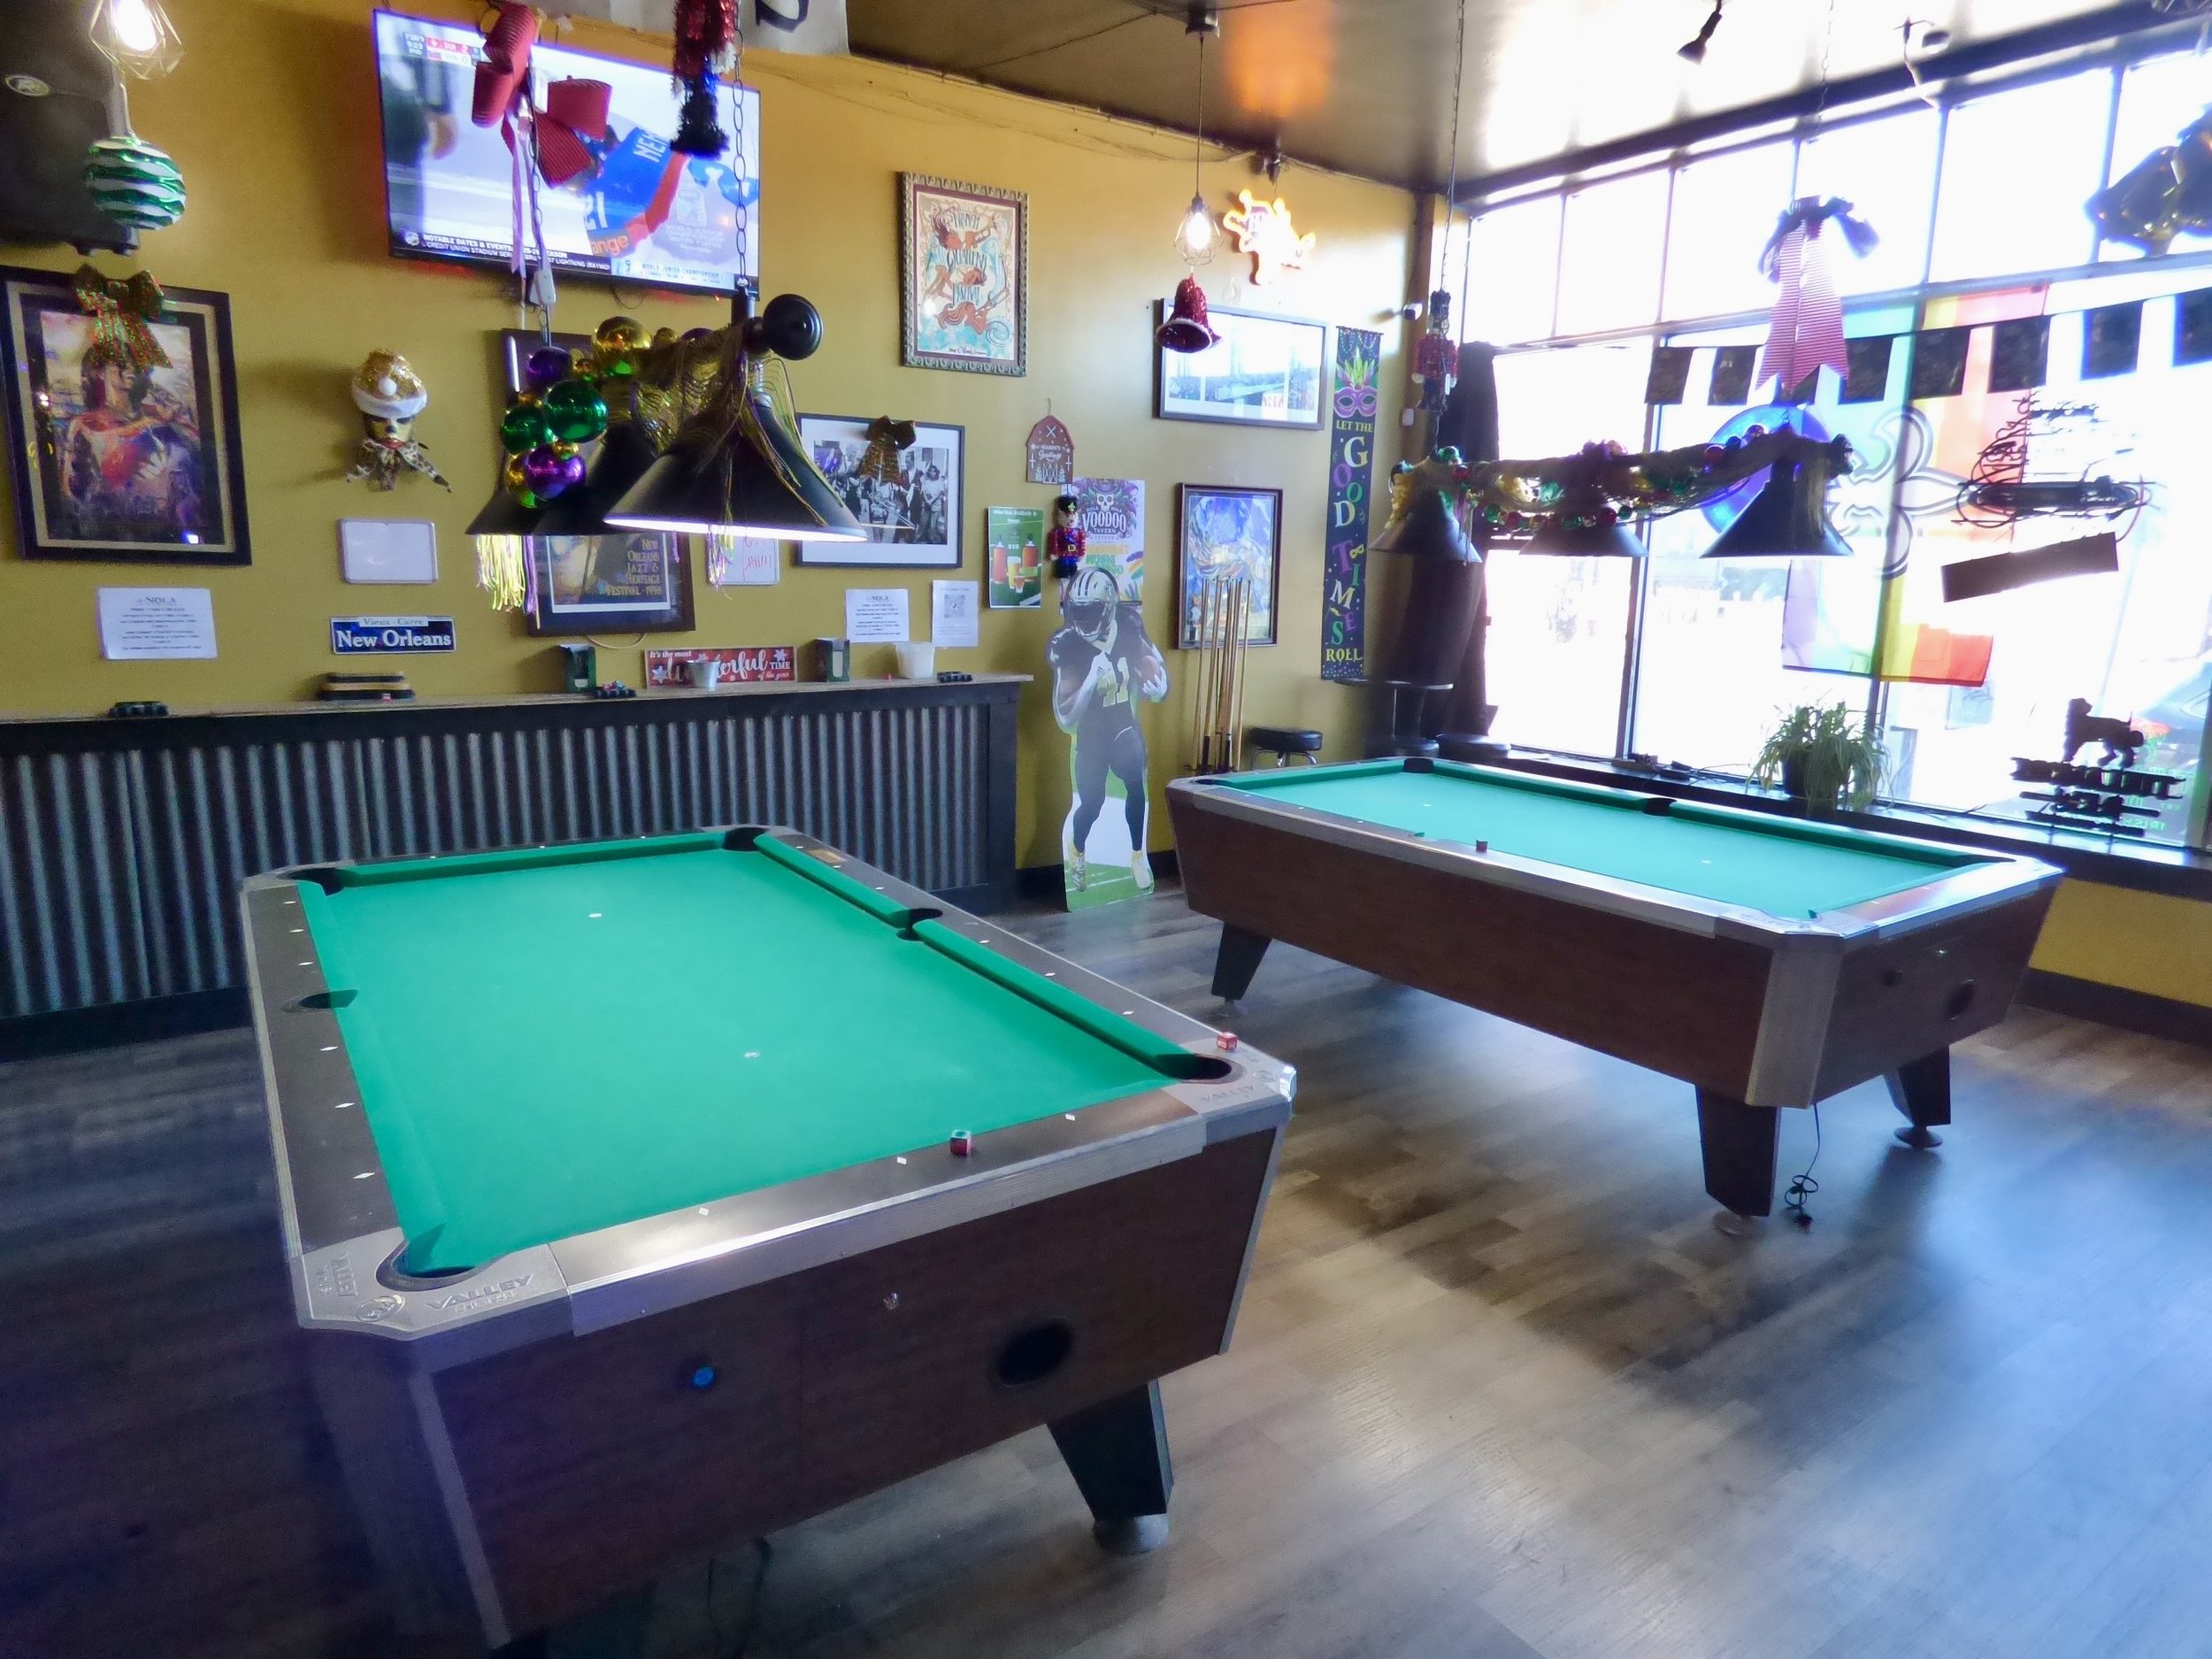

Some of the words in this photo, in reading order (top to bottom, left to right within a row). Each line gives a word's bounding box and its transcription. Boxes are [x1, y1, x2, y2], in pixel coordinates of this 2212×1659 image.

[1336, 419, 1351, 431] LET
[1353, 421, 1373, 433] THE
[1082, 511, 1127, 533] VOODOO
[335, 630, 378, 648] New
[381, 629, 452, 648] Orleans
[1325, 648, 1363, 662] ROLL
[1096, 657, 1130, 708] 41
[426, 1273, 534, 1310] VALLEY
